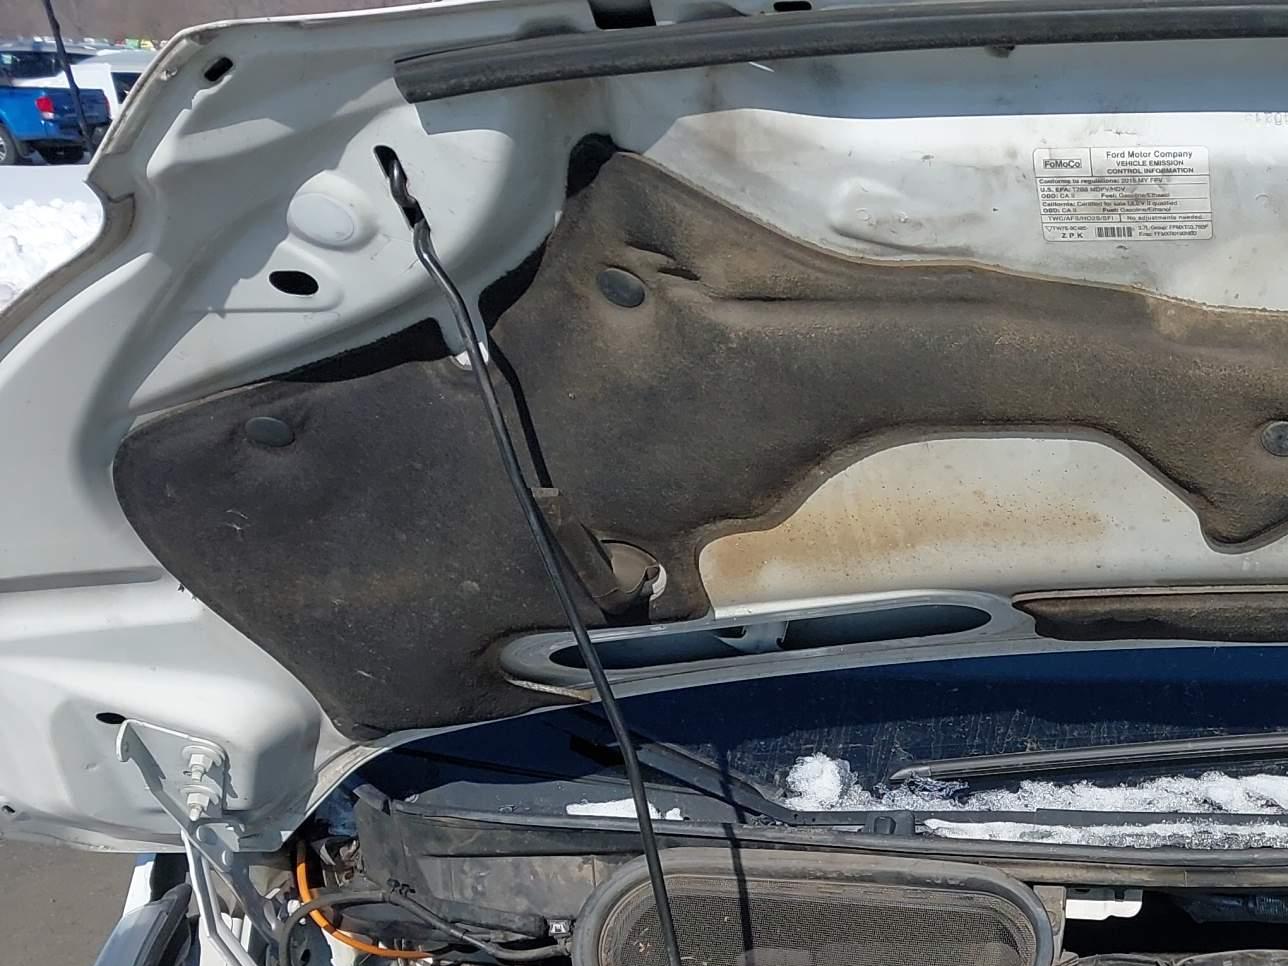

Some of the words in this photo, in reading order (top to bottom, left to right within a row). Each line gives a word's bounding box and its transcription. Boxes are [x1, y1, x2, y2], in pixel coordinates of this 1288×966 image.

[1106, 150, 1125, 159] Ford
[1127, 150, 1151, 159] Motor
[1154, 150, 1193, 159] Company
[1044, 160, 1081, 168] FoMoCo
